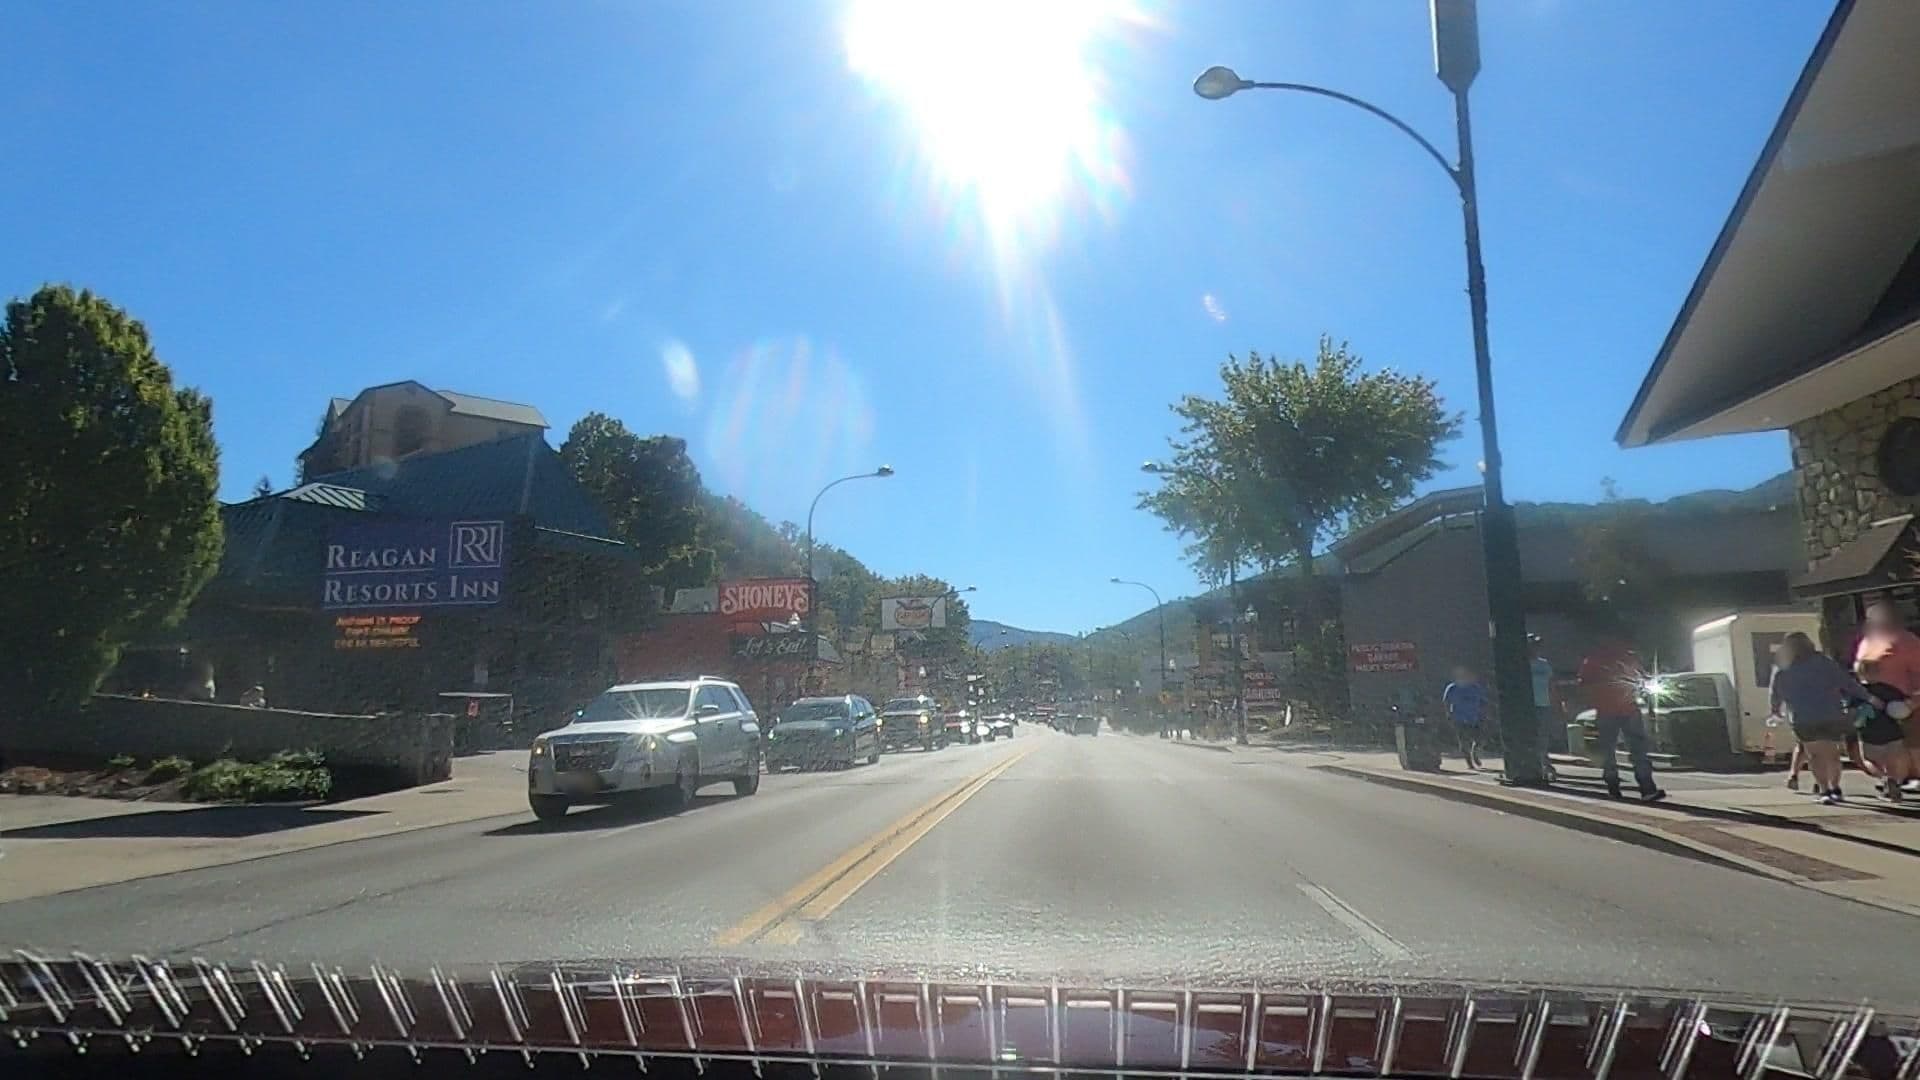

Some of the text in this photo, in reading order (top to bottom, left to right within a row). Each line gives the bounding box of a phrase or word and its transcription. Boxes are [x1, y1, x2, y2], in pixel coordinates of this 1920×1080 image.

[327, 544, 436, 569] REAGAN
[324, 575, 499, 603] RESORTS INN
[720, 583, 809, 615] SHONEY'S
